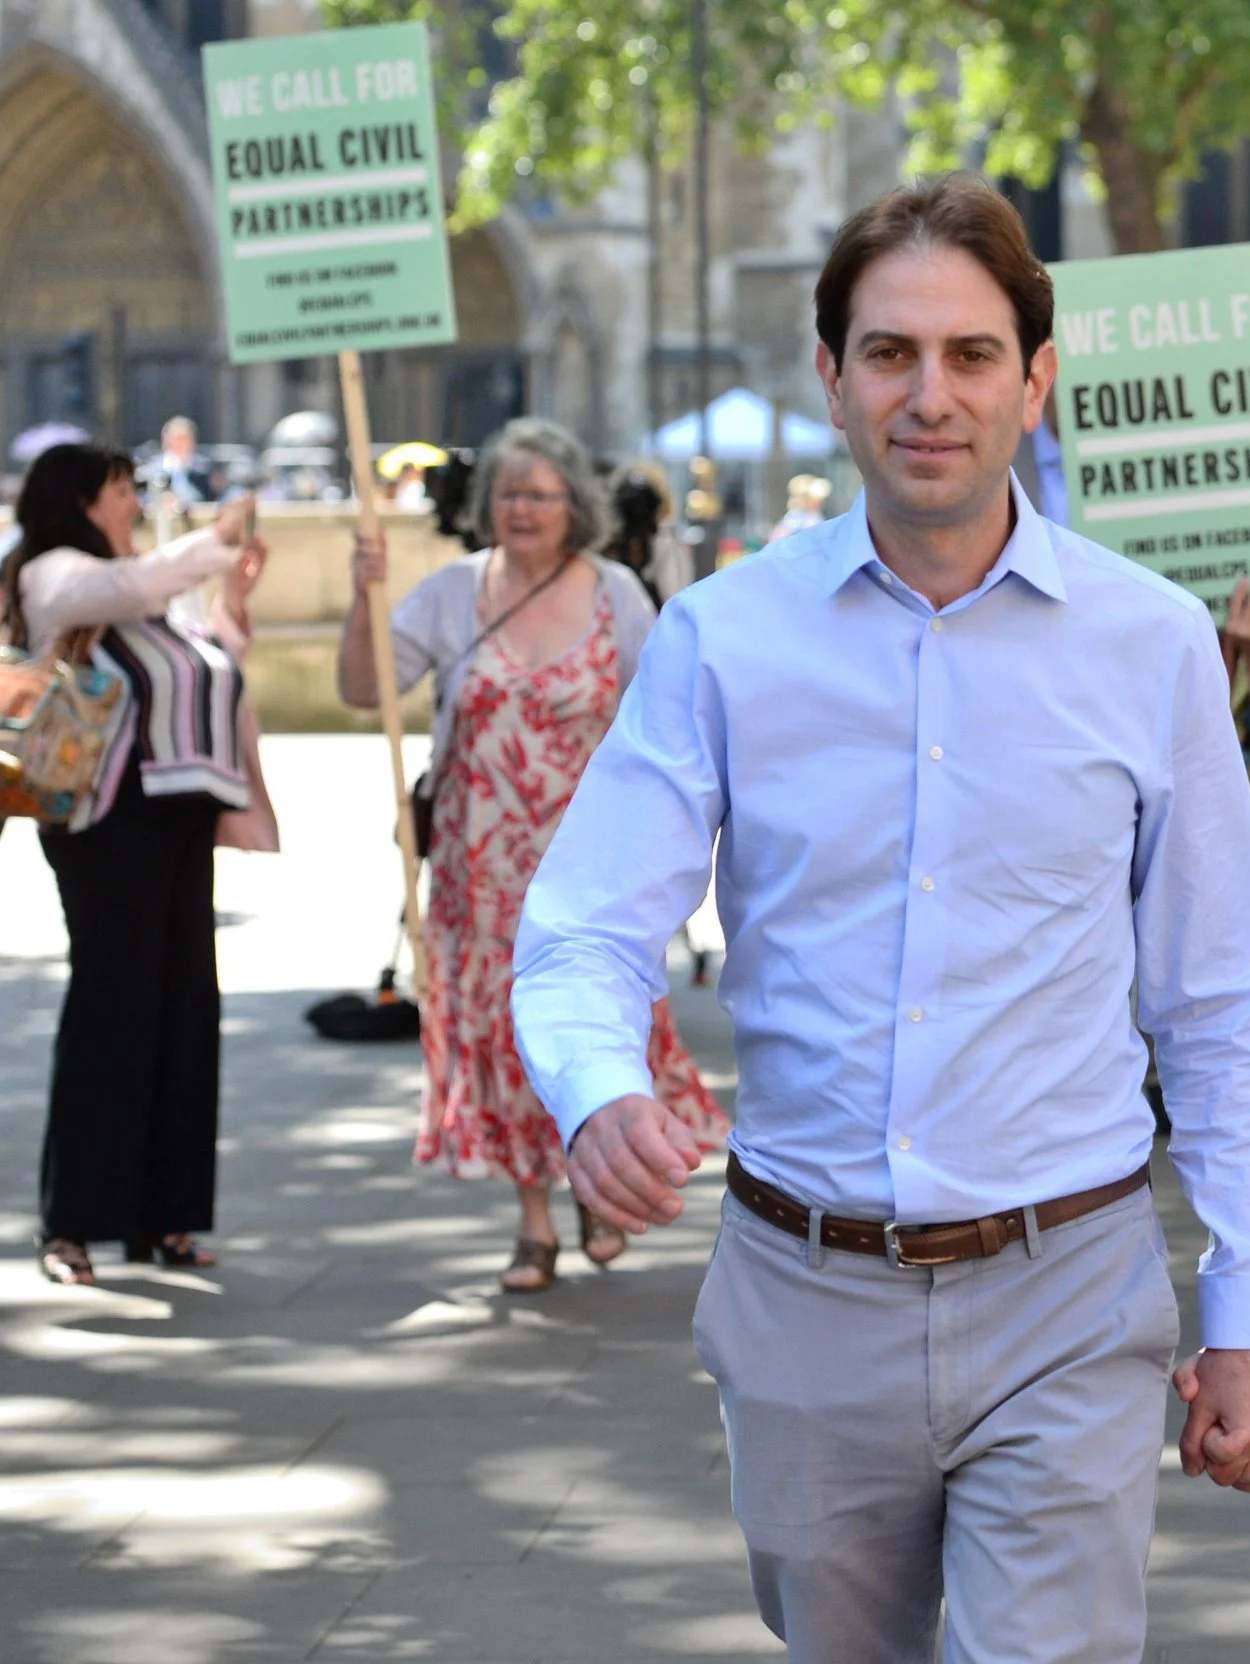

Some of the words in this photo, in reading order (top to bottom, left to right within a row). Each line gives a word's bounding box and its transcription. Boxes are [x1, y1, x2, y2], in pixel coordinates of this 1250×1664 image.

[216, 75, 264, 118] WE
[272, 66, 349, 112] CALL
[355, 59, 418, 102] FOR
[226, 133, 324, 181] EQUAL
[340, 122, 424, 167] CIVIL
[232, 189, 430, 236] PARTNERSHIPS
[1060, 308, 1118, 357] WE
[1129, 297, 1222, 350] CALL
[1072, 375, 1195, 430] EQUAL
[1124, 537, 1156, 555] FIND
[1161, 536, 1178, 553] US
[1183, 532, 1201, 550] ON
